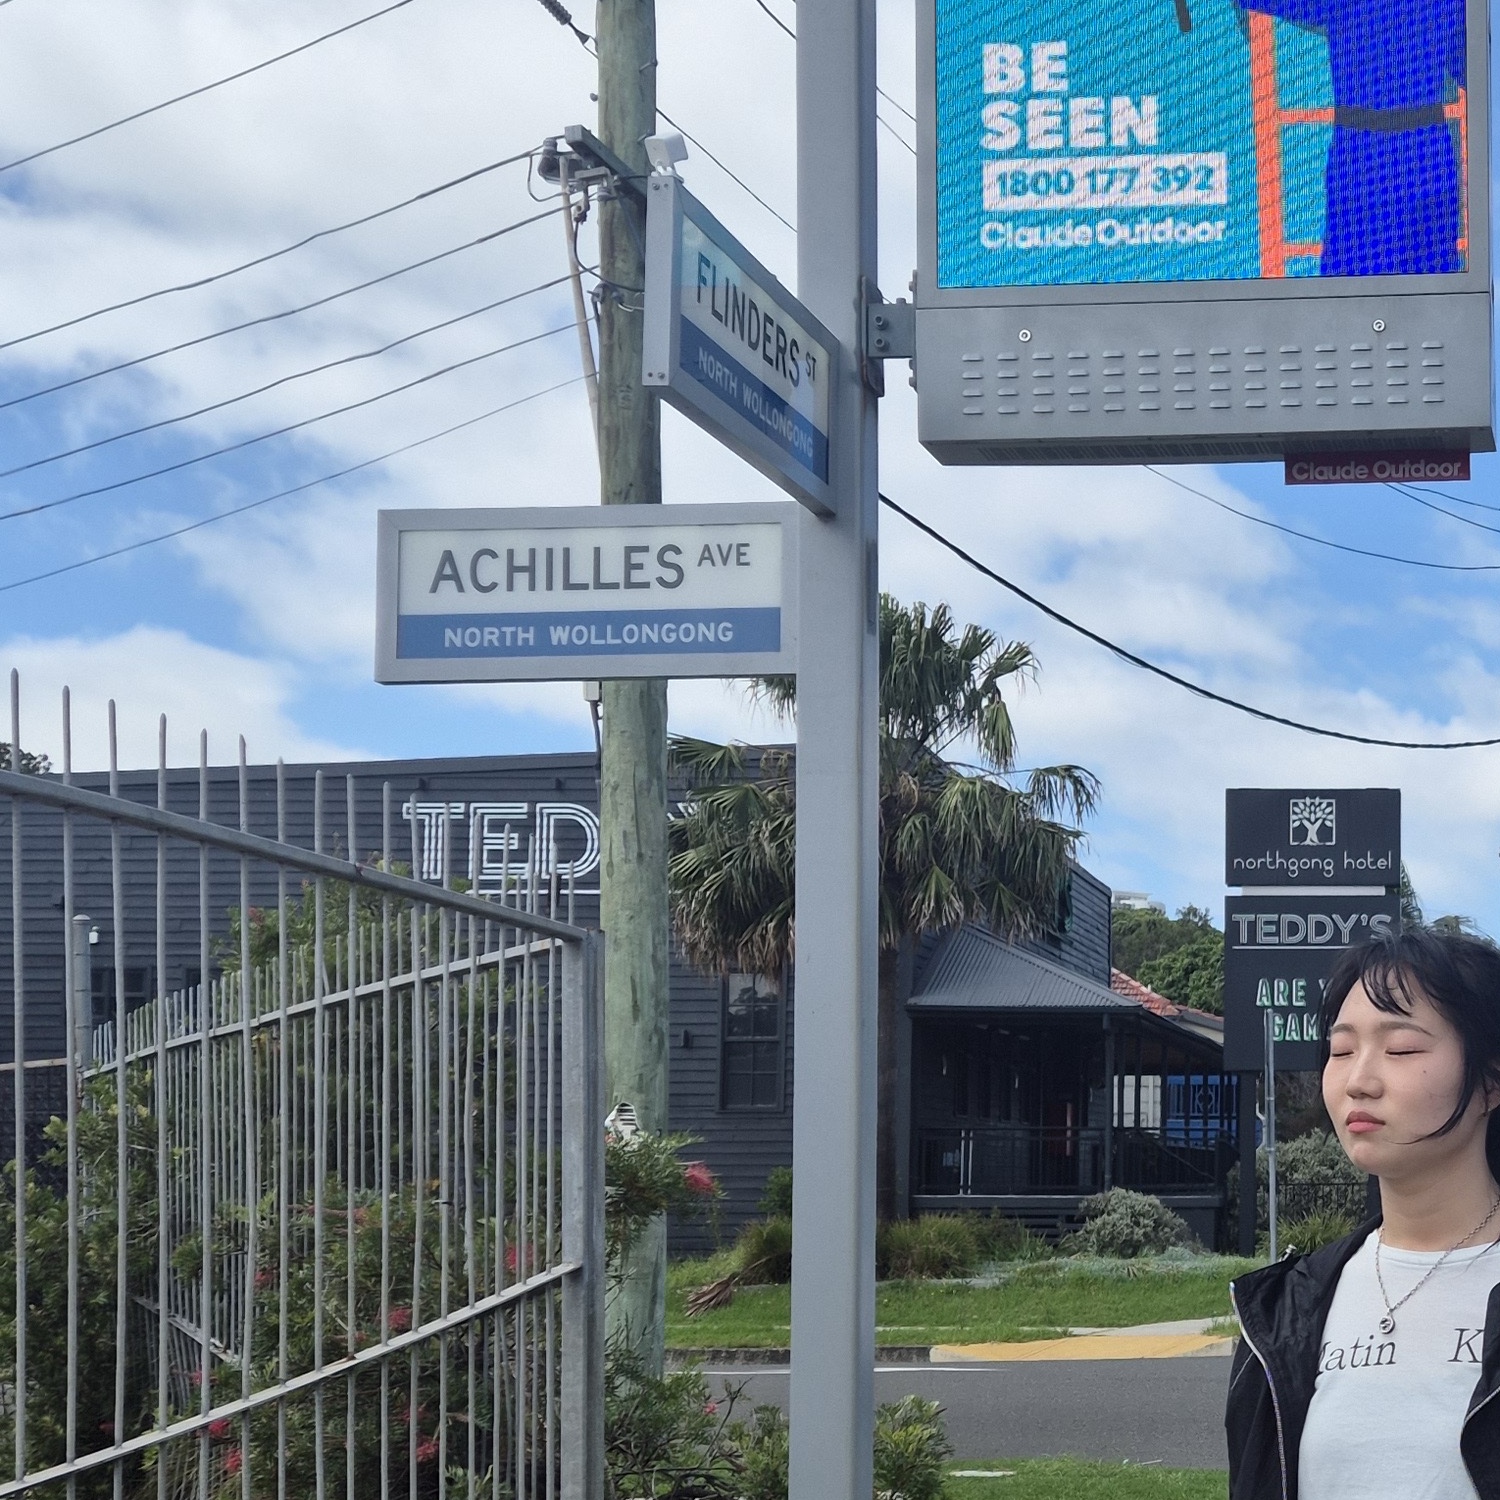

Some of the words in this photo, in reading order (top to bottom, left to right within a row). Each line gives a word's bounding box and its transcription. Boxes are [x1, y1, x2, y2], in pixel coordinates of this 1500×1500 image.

[982, 40, 1068, 94] BE
[980, 94, 1159, 150] SEEN
[996, 169, 1076, 198] 1800
[1085, 166, 1139, 194] 177
[1150, 164, 1214, 192] 392
[980, 219, 1093, 249] Claude
[1098, 217, 1226, 246] Outdoor
[696, 251, 800, 388] FLINDERS
[805, 351, 817, 381] ST
[699, 347, 738, 398] NORTH
[743, 383, 814, 458] WOLLONGONG
[1291, 461, 1370, 481] Claude
[429, 544, 685, 593] ACHILLES
[697, 542, 751, 567] AVE
[444, 626, 535, 648] NORTH
[549, 622, 734, 646] WOLLONGONG
[402, 802, 600, 880] TED
[1233, 851, 1335, 878] northgong
[1344, 851, 1392, 870] hotel
[1231, 913, 1392, 945] TEDDY'S
[1256, 978, 1307, 1008] ARE
[1272, 1013, 1322, 1042] GAM
